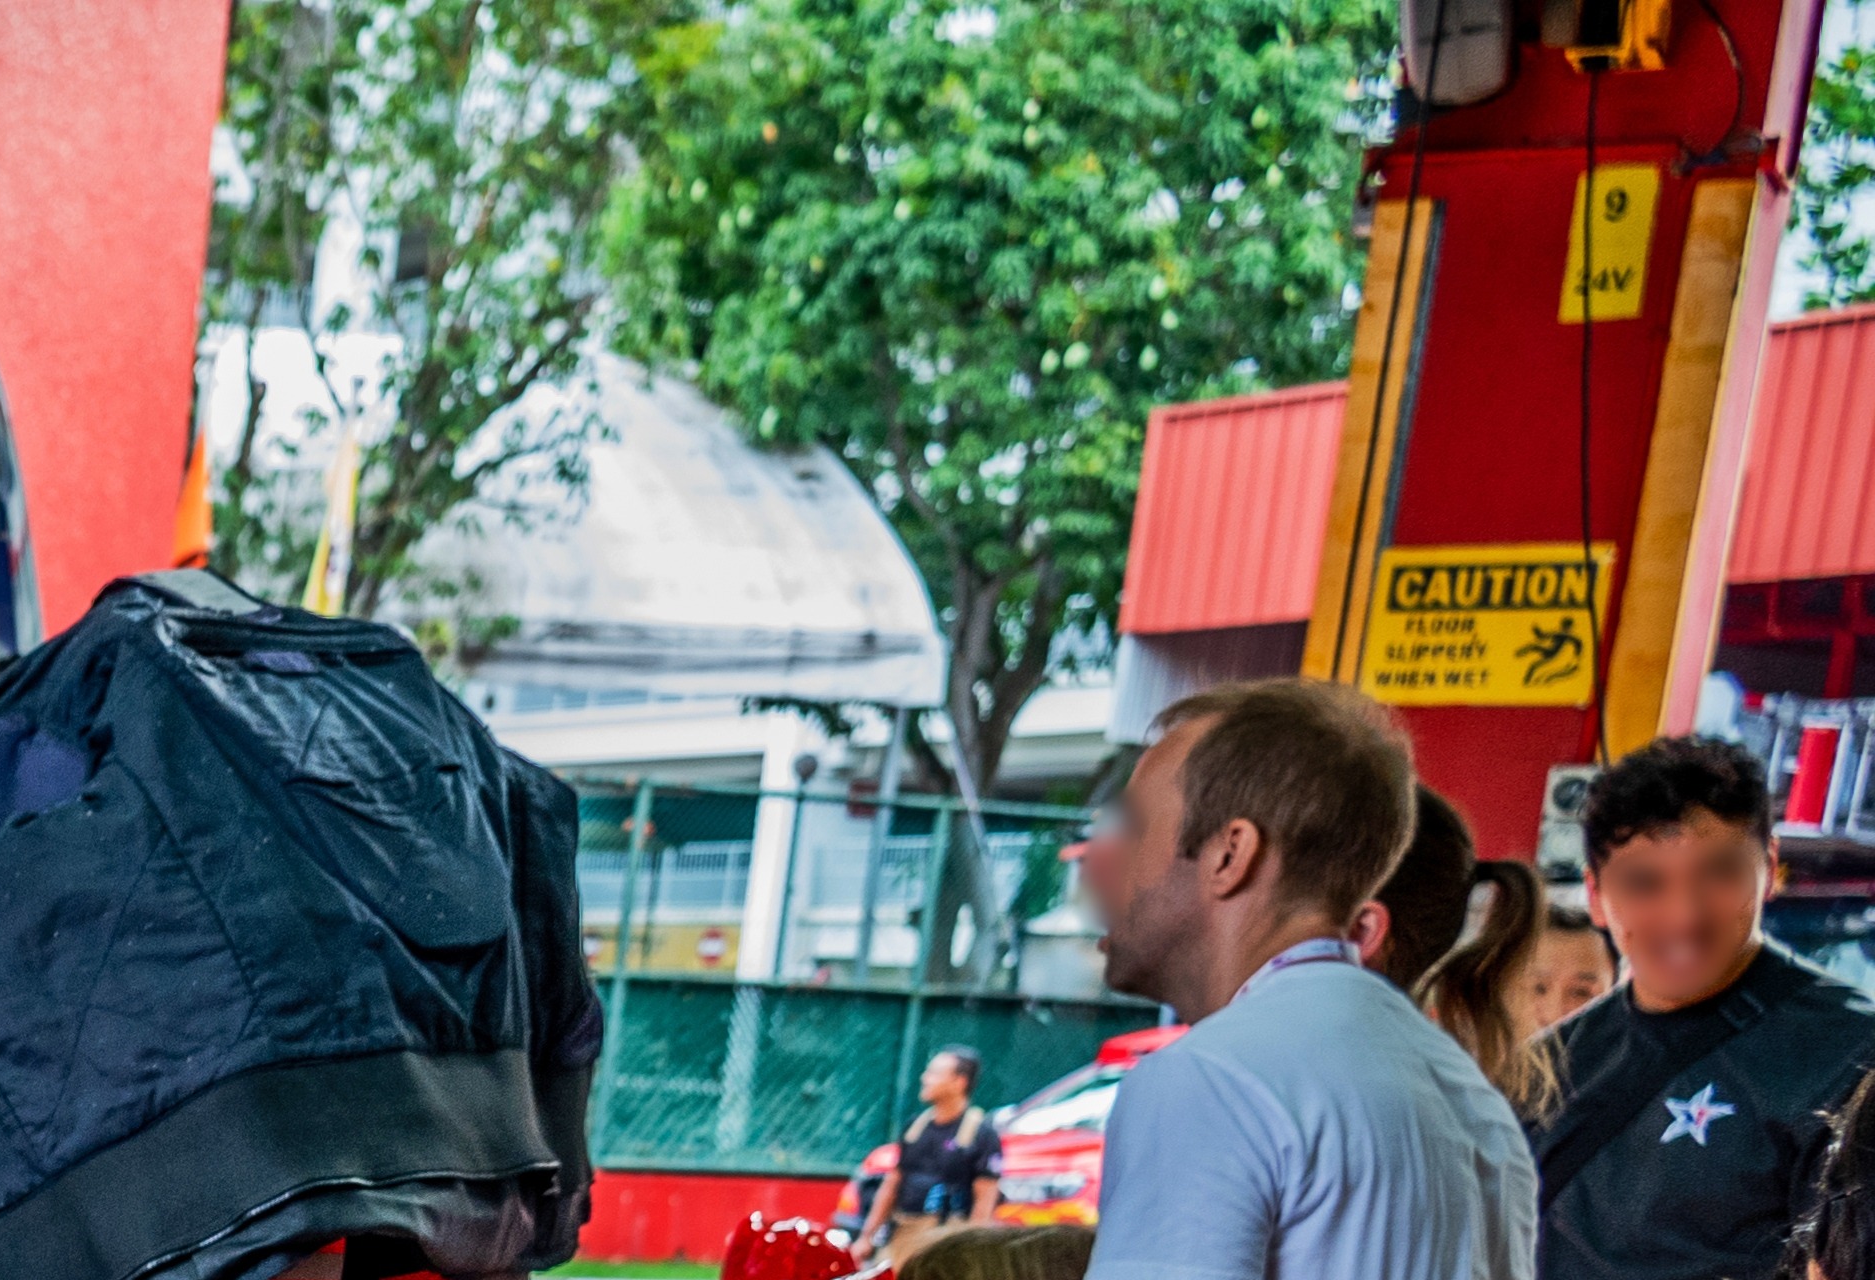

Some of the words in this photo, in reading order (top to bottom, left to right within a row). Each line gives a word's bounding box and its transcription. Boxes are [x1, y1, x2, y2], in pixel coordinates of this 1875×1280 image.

[1605, 186, 1629, 222] 9
[1395, 567, 1588, 606] CAUTION
[1405, 617, 1475, 634] FLOOR
[1385, 643, 1487, 662] SLIPPERY
[1375, 669, 1437, 687] WHEN
[1444, 669, 1490, 688] WET
